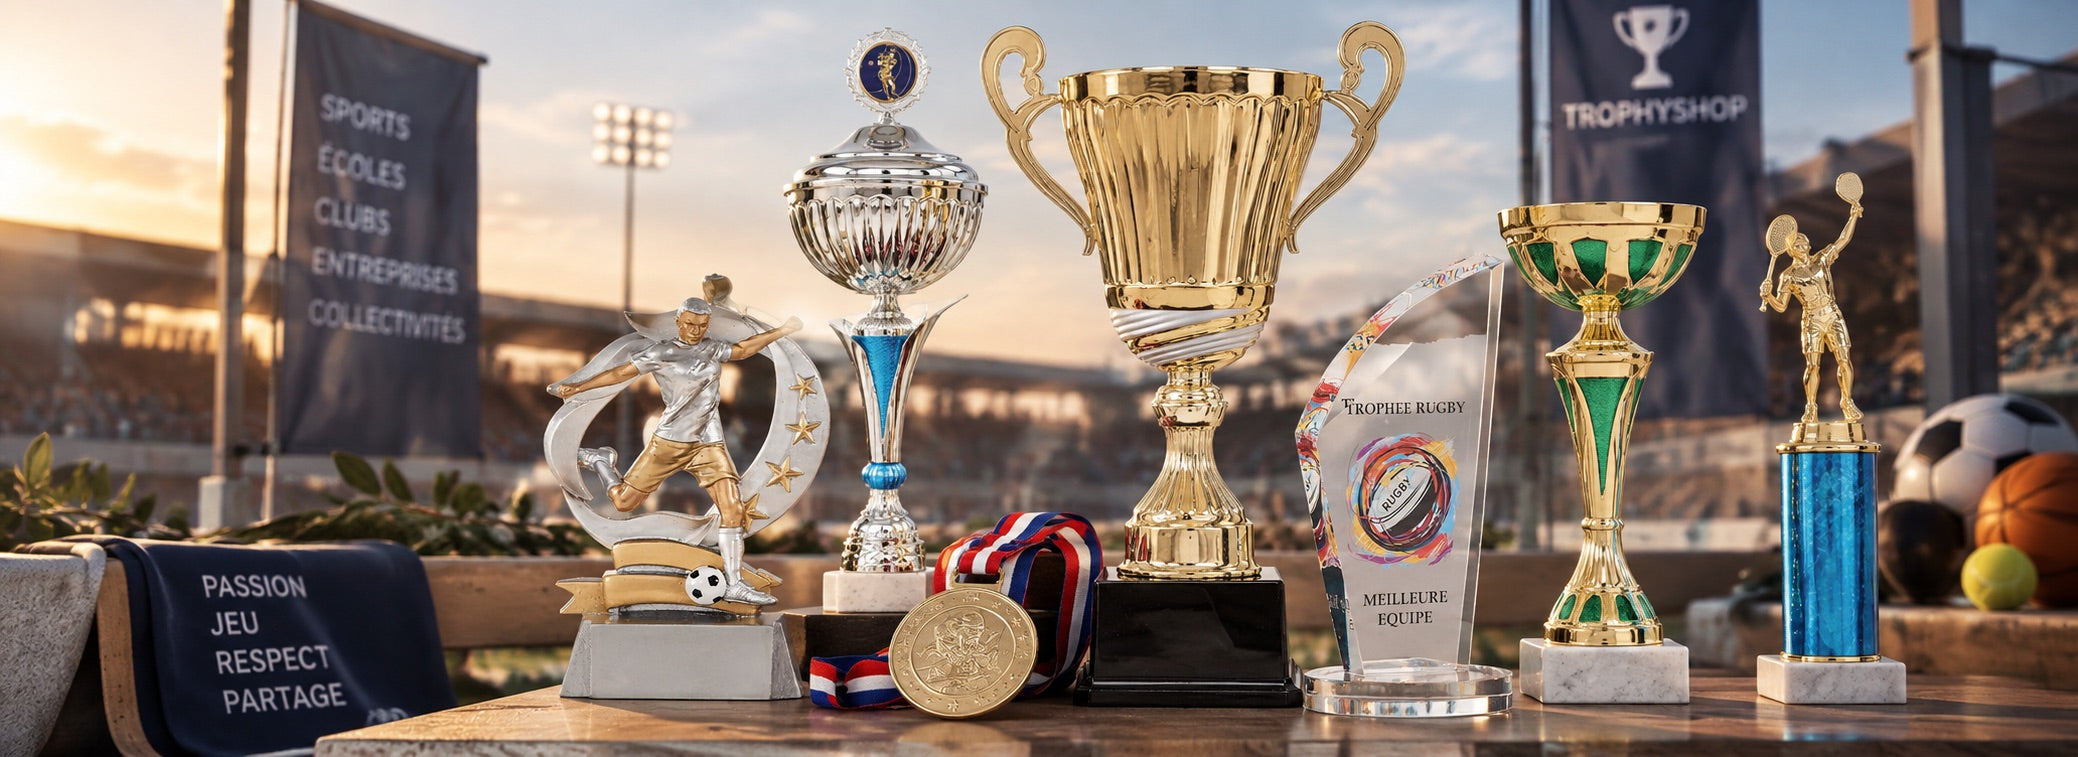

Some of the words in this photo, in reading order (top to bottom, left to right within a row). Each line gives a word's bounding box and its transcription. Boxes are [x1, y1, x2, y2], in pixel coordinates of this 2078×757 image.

[320, 94, 411, 140] SPORTS
[1561, 95, 1748, 130] TROPHYSHOP
[317, 141, 406, 190] ÉCOLES
[314, 196, 391, 236] CLUBS
[311, 247, 458, 295] ENTREPRISES
[308, 298, 466, 344] COLLECTIVITÉS
[1416, 401, 1466, 414] RUGBY
[1382, 476, 1410, 512] RUGBY
[202, 574, 307, 598] PASSION
[1363, 590, 1448, 606] MEILLEURE
[211, 611, 259, 636] JEU
[1378, 611, 1433, 628] EQUIPE
[215, 645, 329, 675] RESPECT
[223, 682, 347, 714] PARTAGE
